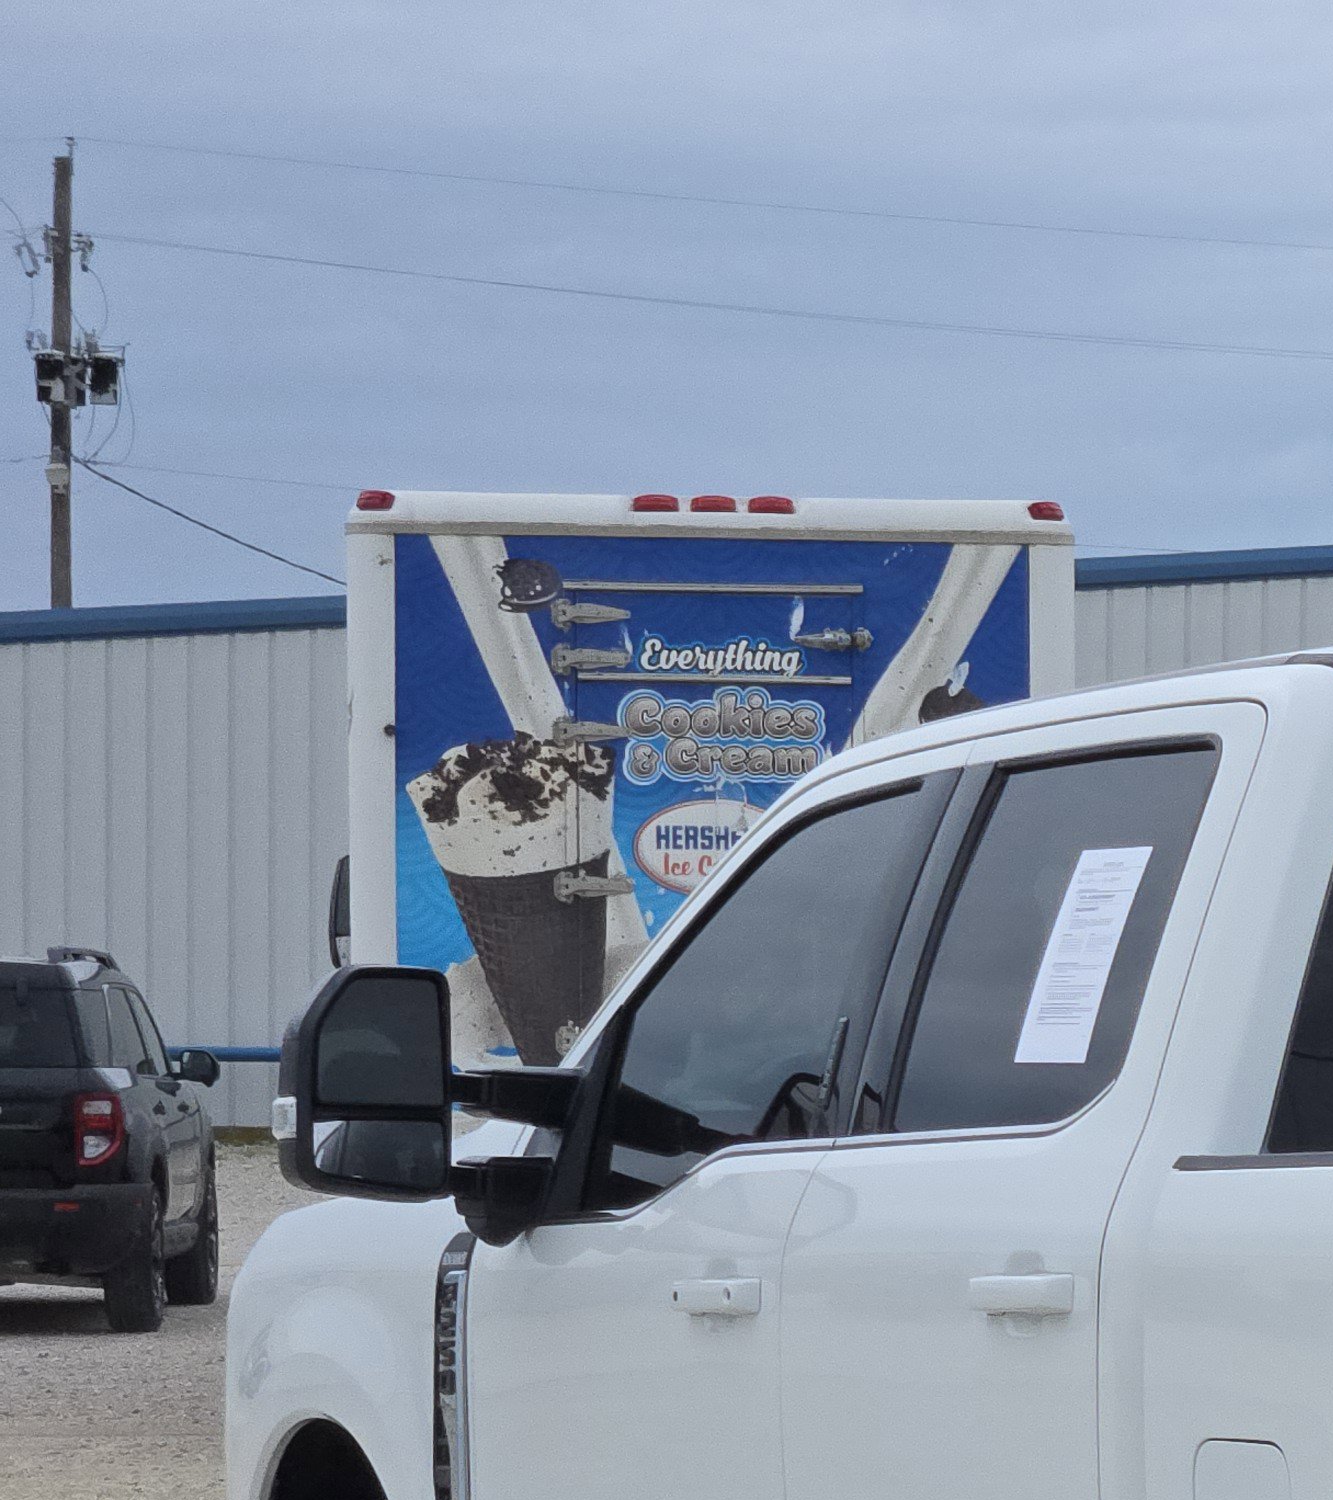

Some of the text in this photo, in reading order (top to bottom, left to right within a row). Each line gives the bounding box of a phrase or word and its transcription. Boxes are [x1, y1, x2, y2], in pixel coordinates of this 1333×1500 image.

[640, 637, 803, 679] Everything
[626, 692, 819, 738] Cookies
[632, 737, 818, 778] & Cream
[663, 851, 692, 876] Ice
